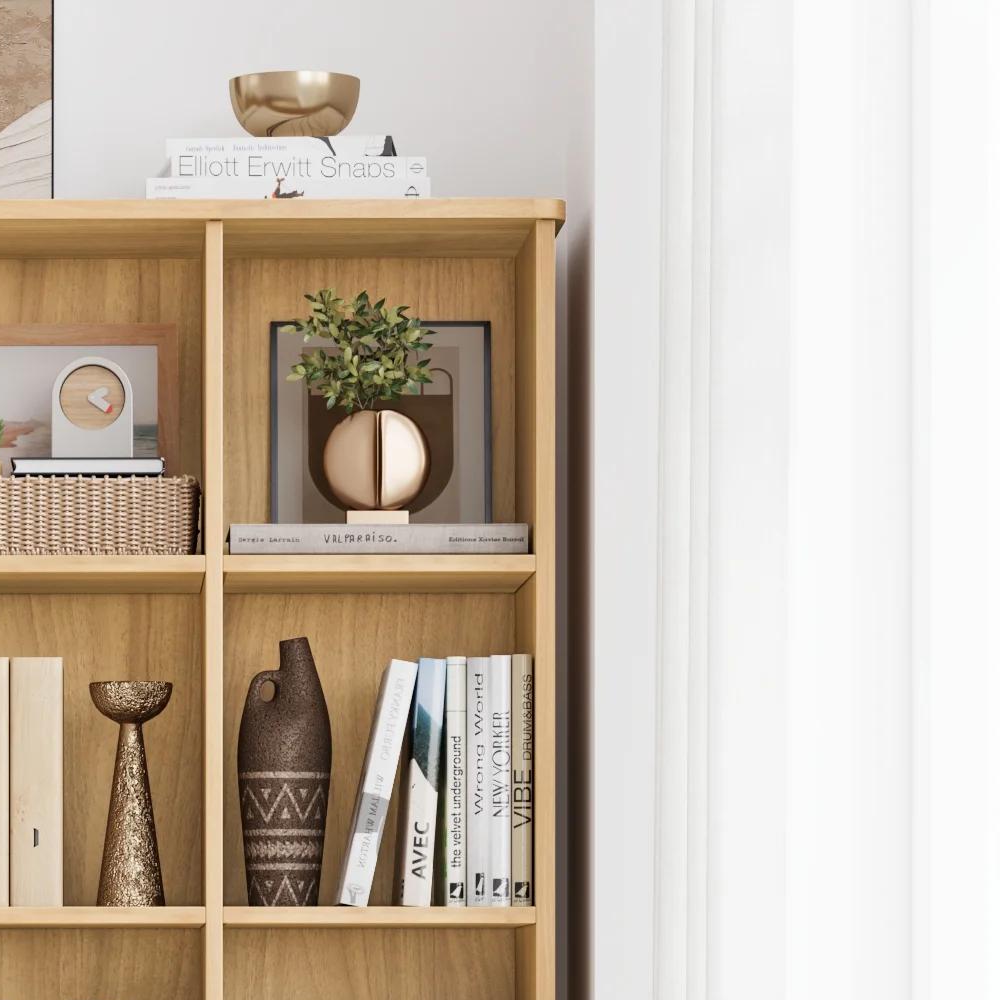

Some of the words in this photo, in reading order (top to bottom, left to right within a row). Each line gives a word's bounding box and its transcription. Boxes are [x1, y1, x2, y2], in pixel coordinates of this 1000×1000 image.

[179, 154, 240, 177] Elliott
[248, 154, 312, 177] Erwitt
[320, 154, 395, 178] Snaps
[475, 673, 484, 736] World
[522, 674, 532, 761] DRUM&BASS
[451, 735, 464, 810] underground
[492, 711, 510, 778] YORKER
[475, 744, 485, 815] Wrong
[492, 779, 510, 818] NEW
[513, 769, 532, 829] VIBE
[411, 820, 430, 880] AVEC
[451, 813, 462, 846] velvet
[451, 847, 462, 868] the
